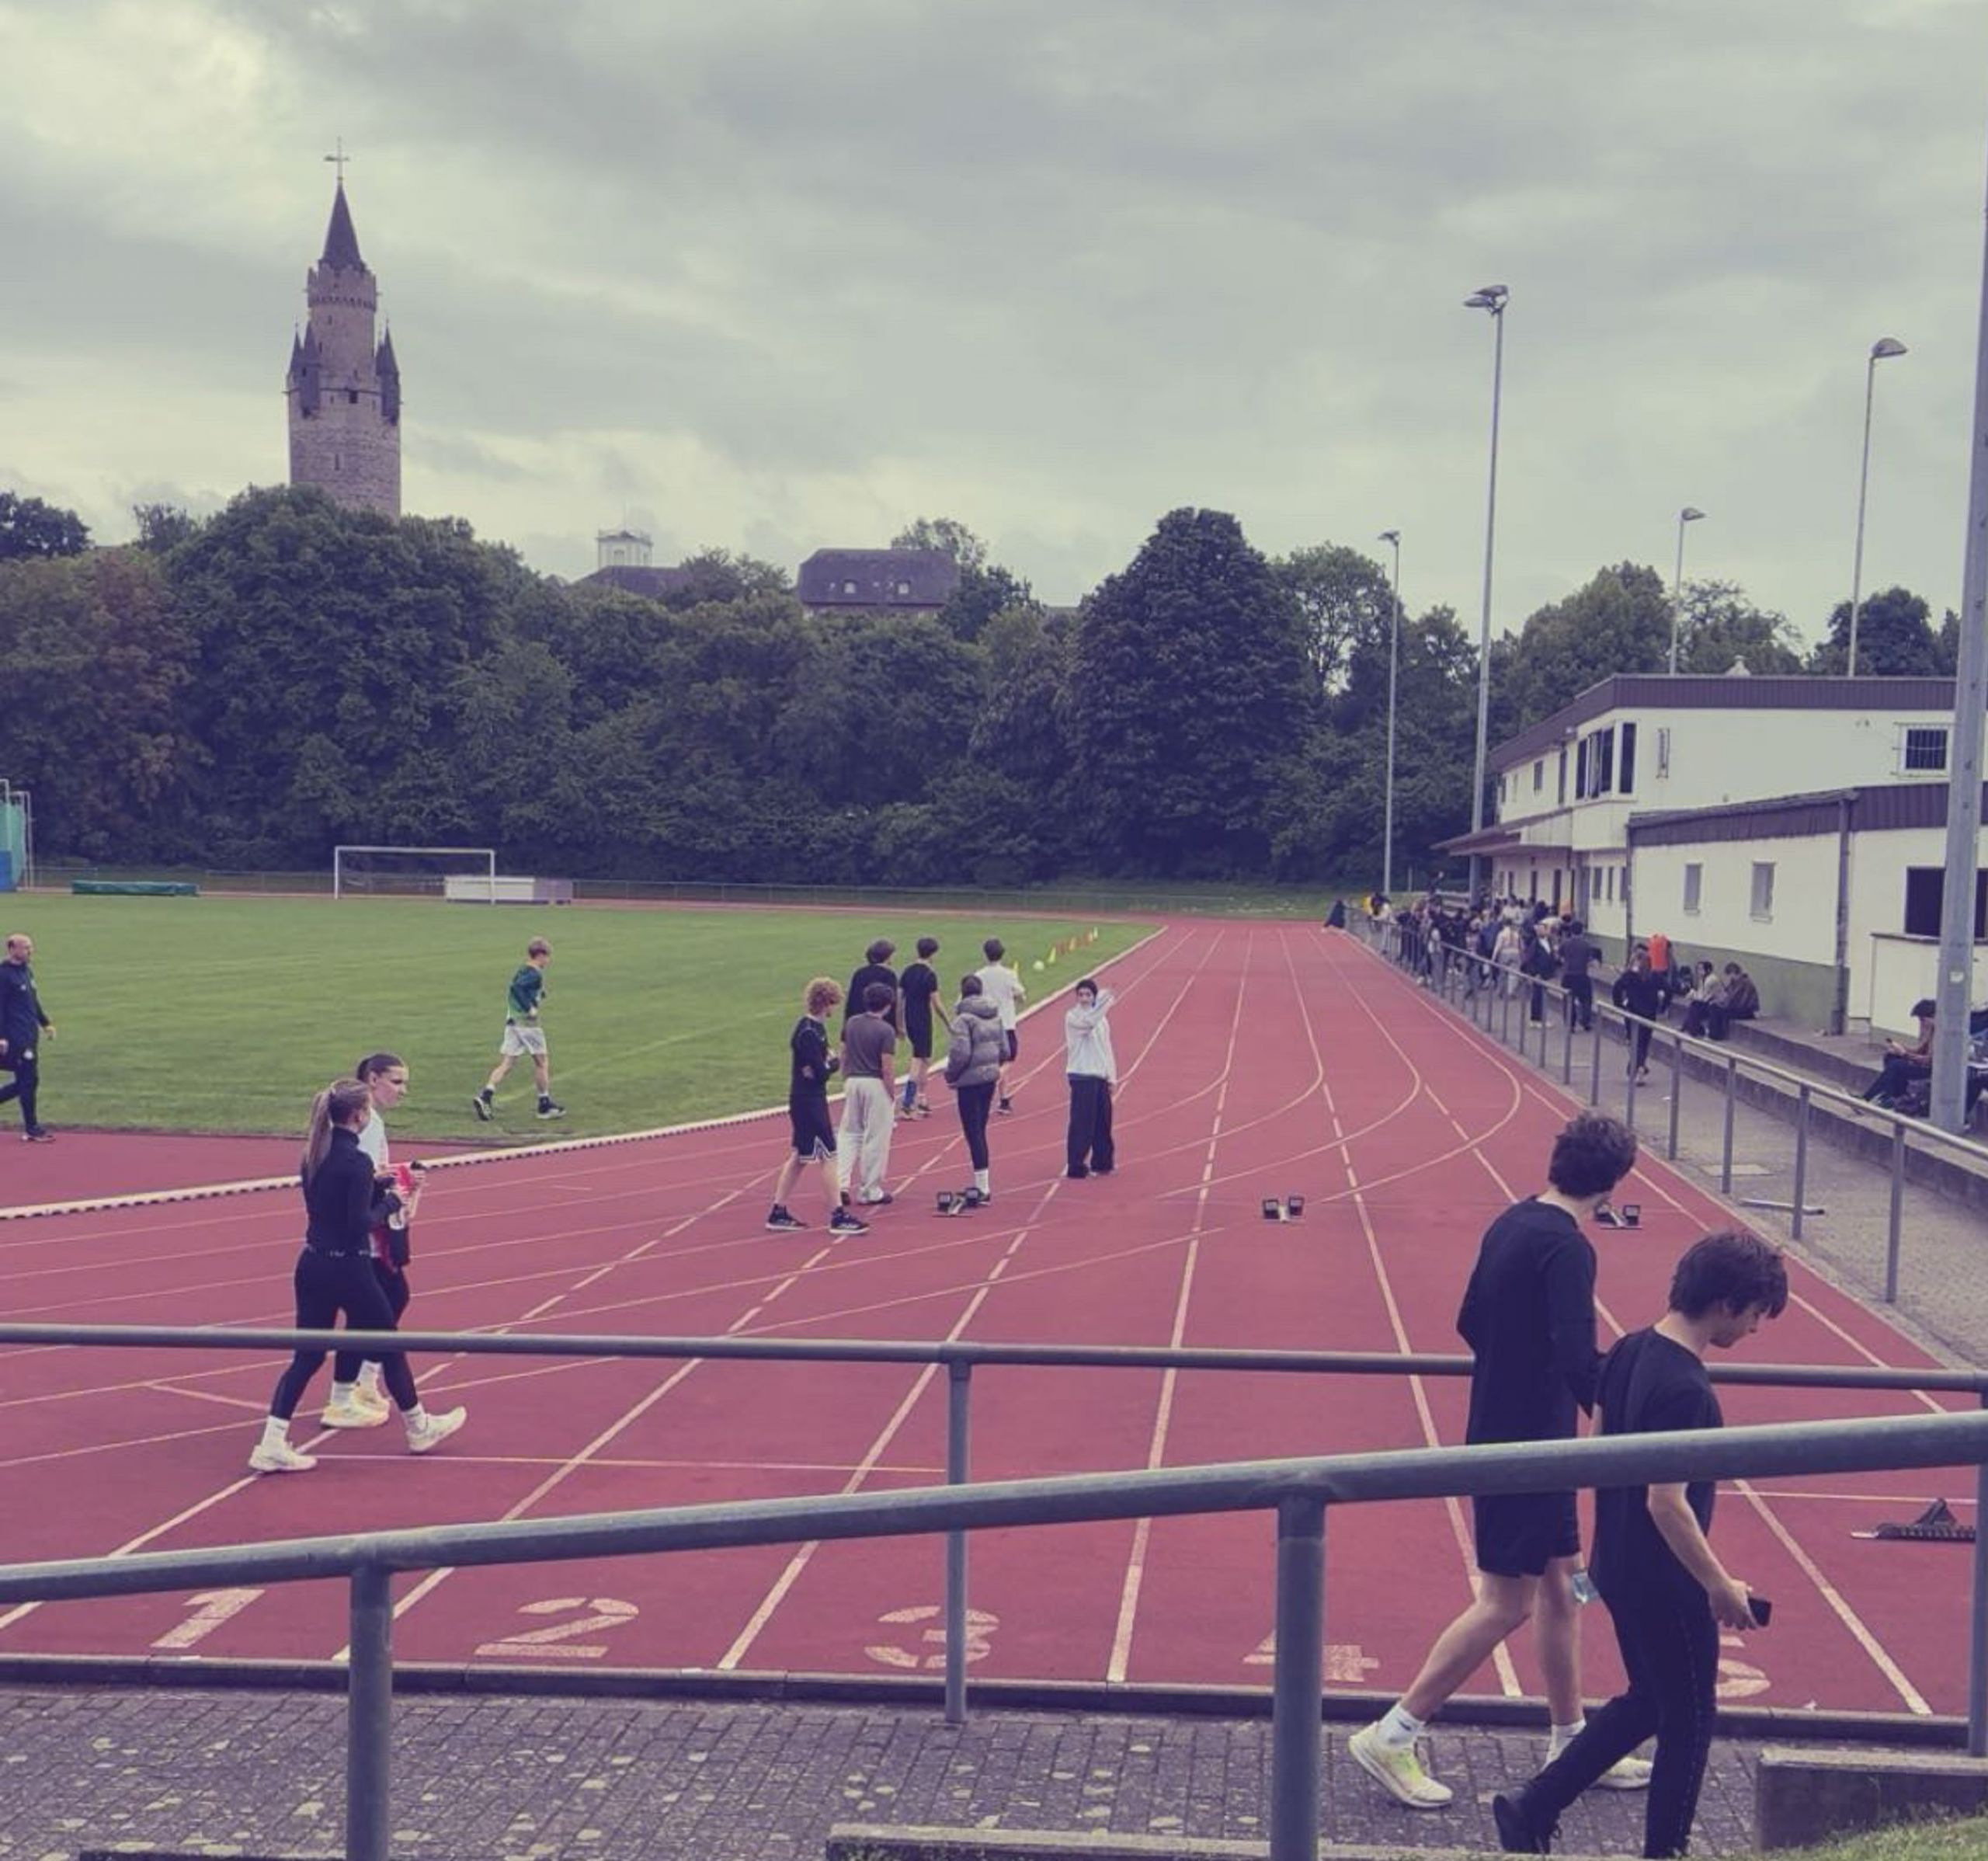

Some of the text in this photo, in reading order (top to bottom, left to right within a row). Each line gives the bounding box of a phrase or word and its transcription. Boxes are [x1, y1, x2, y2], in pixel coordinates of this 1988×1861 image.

[149, 1588, 266, 1648] 1
[474, 1597, 639, 1658] 2
[864, 1605, 1000, 1668] 3
